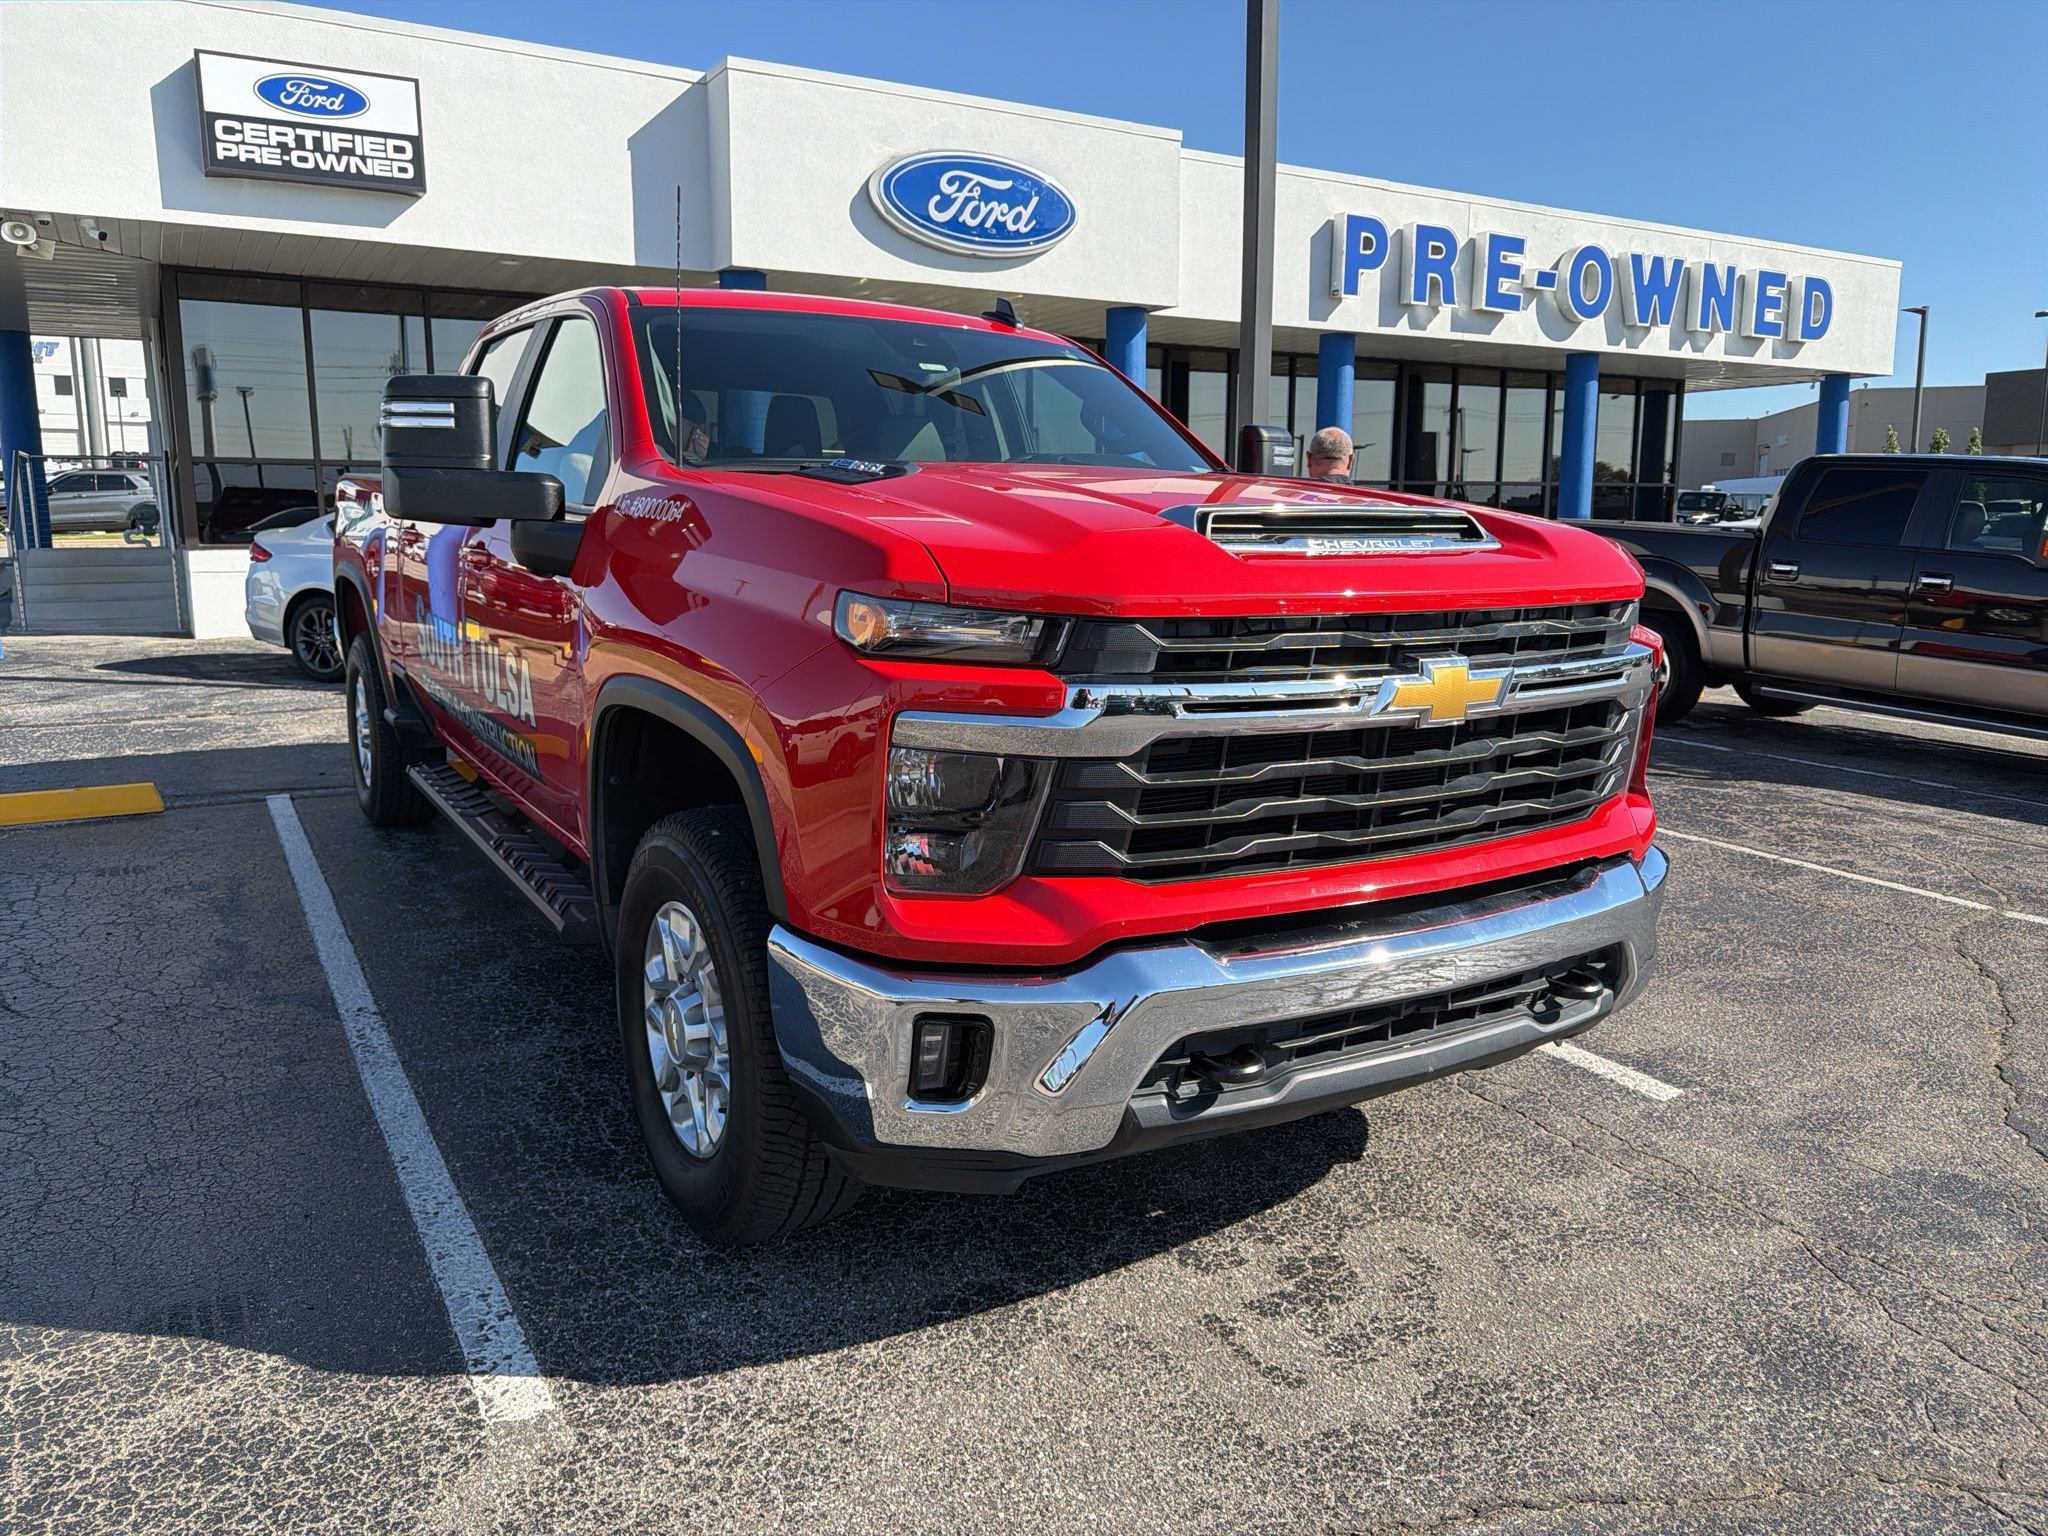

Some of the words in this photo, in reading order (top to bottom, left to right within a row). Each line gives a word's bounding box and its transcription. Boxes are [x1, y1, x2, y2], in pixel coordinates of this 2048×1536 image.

[280, 80, 345, 111] Ford
[214, 119, 413, 161] CERTIFIED
[215, 142, 415, 180] PRE-OWNED
[928, 170, 1040, 234] Ford
[1340, 211, 1835, 343] PRE-OWNED
[1307, 538, 1435, 549] CHEVROLET
[415, 593, 466, 686] SOUTH
[466, 618, 537, 728] TULSA
